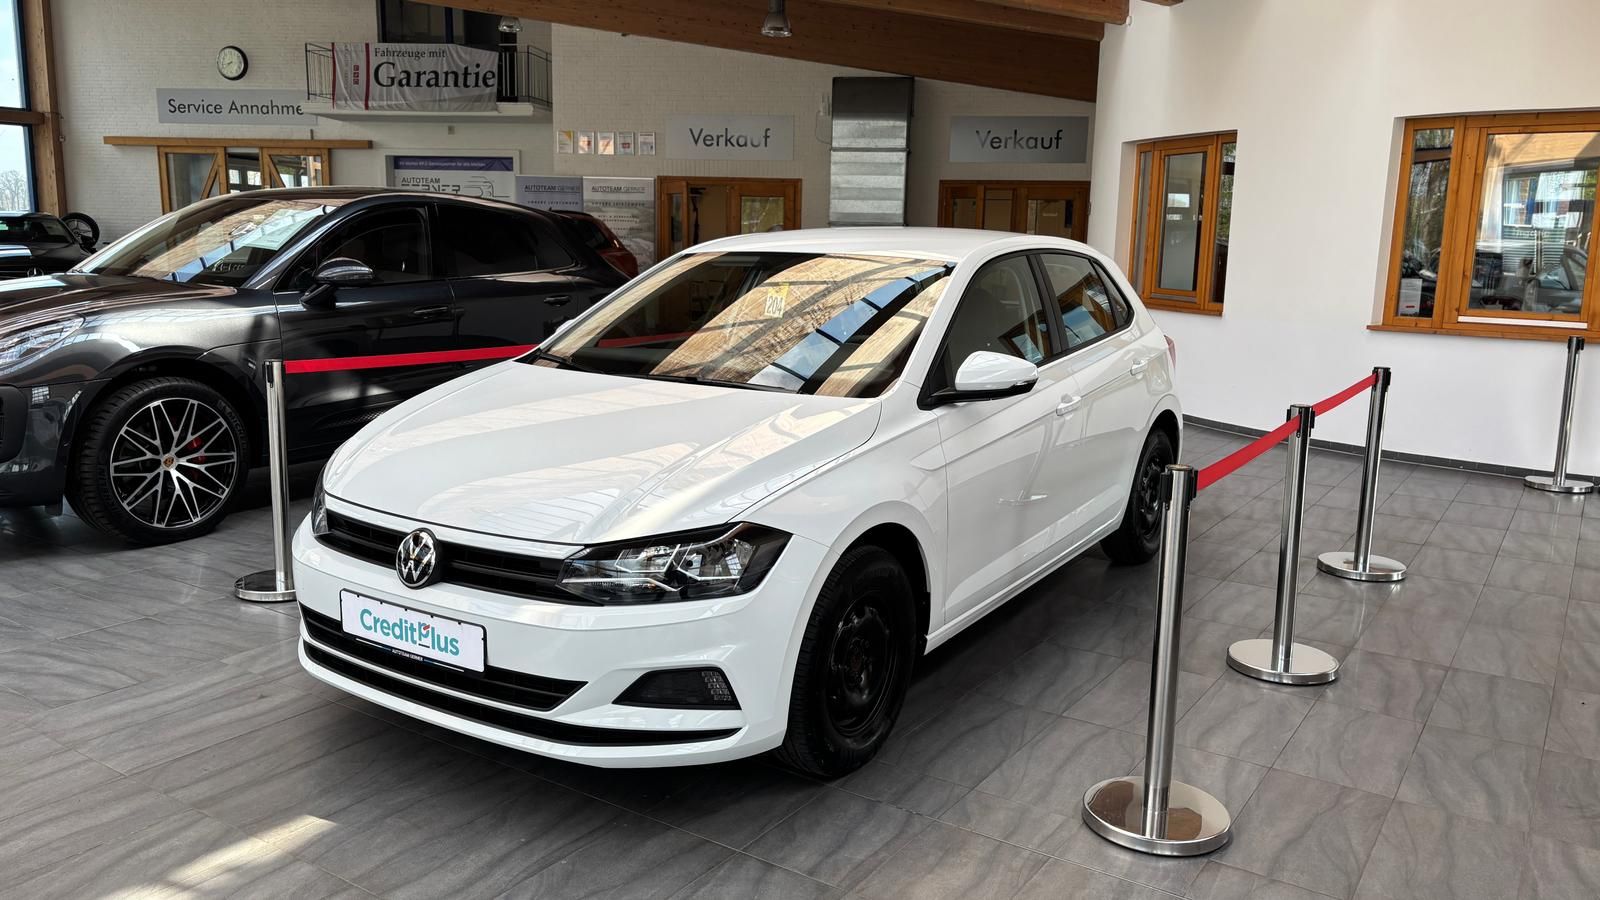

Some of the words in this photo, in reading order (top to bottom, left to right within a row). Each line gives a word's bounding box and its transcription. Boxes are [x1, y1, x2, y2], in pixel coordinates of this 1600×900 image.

[374, 47, 426, 60] Fahrzeuge
[428, 47, 447, 58] mit
[373, 61, 496, 88] Garantie
[168, 98, 223, 114] Service
[228, 99, 305, 115] Annahme
[688, 127, 771, 148] Verkauf
[975, 129, 1063, 150] Verkauf
[766, 295, 784, 316] 204
[360, 608, 460, 656] CreditPlus
